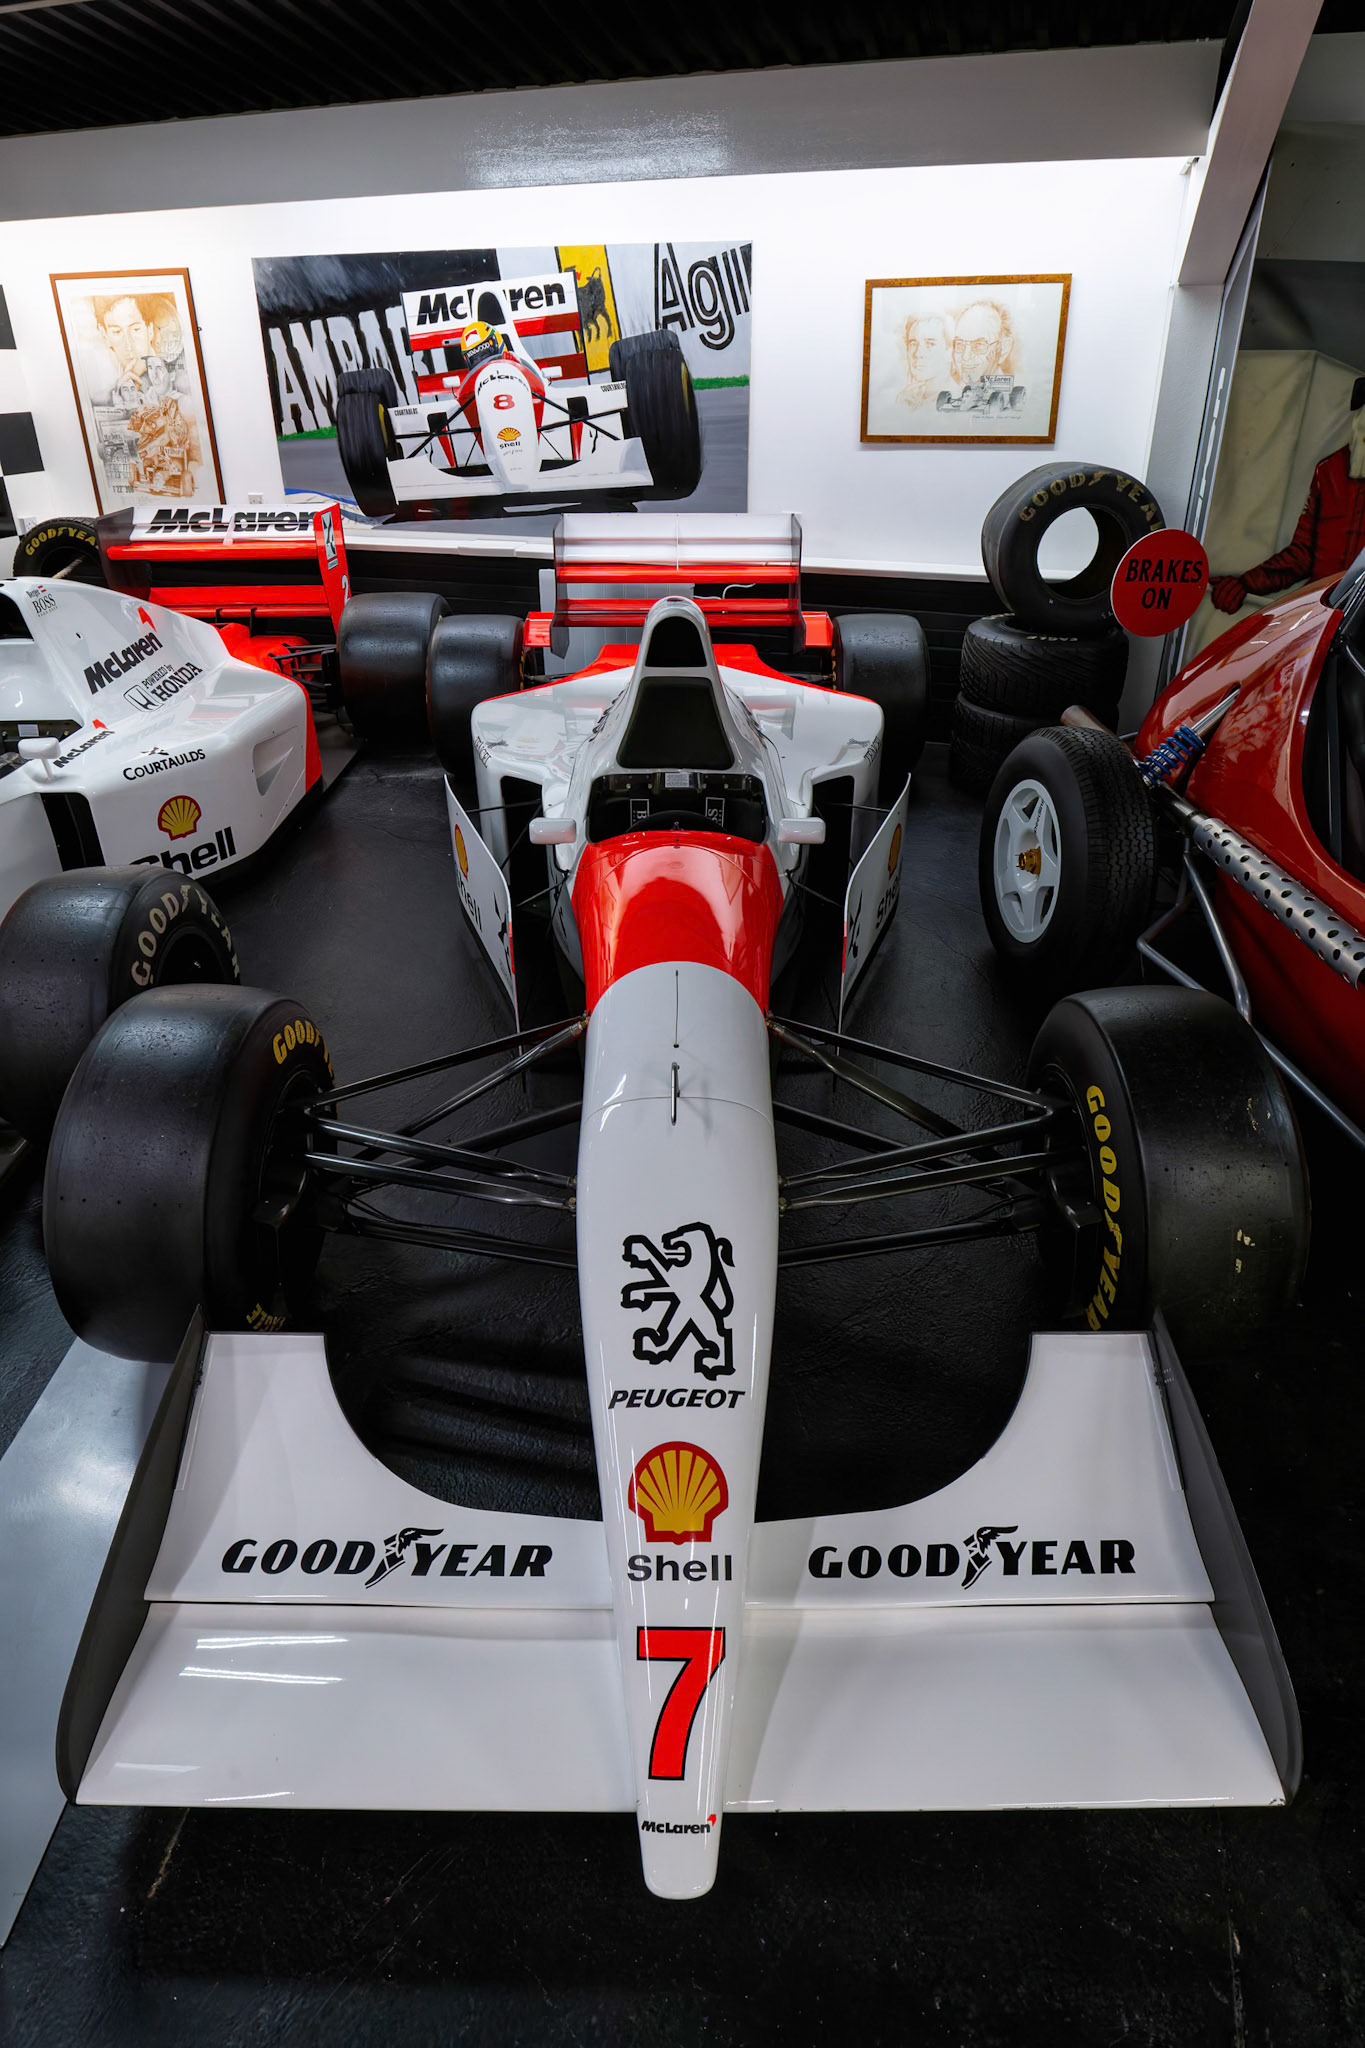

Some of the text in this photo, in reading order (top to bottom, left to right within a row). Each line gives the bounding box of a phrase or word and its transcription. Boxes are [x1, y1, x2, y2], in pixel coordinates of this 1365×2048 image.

[417, 282, 566, 326] Mcren
[493, 394, 515, 410] 8
[145, 507, 318, 535] McLaren
[24, 526, 99, 557] GOODYEA
[1125, 558, 1203, 583] BRAKES
[32, 593, 56, 614] BOSS
[1141, 587, 1172, 610] ON
[84, 632, 164, 695] McLaren
[141, 666, 169, 689] POWERED
[151, 662, 203, 702] HONDA
[53, 729, 115, 768] McLaren
[122, 748, 206, 781] COURTAULDS
[456, 874, 483, 933] hell
[1086, 1084, 1123, 1332] GOODYEAR
[608, 1388, 746, 1409] PEUGEOT
[221, 1538, 553, 1577] GOODYEAR
[627, 1554, 732, 1582] Shell
[808, 1539, 1136, 1579] GOODYEAR
[636, 1626, 726, 1781] 7
[641, 1820, 711, 1834] McLaren
